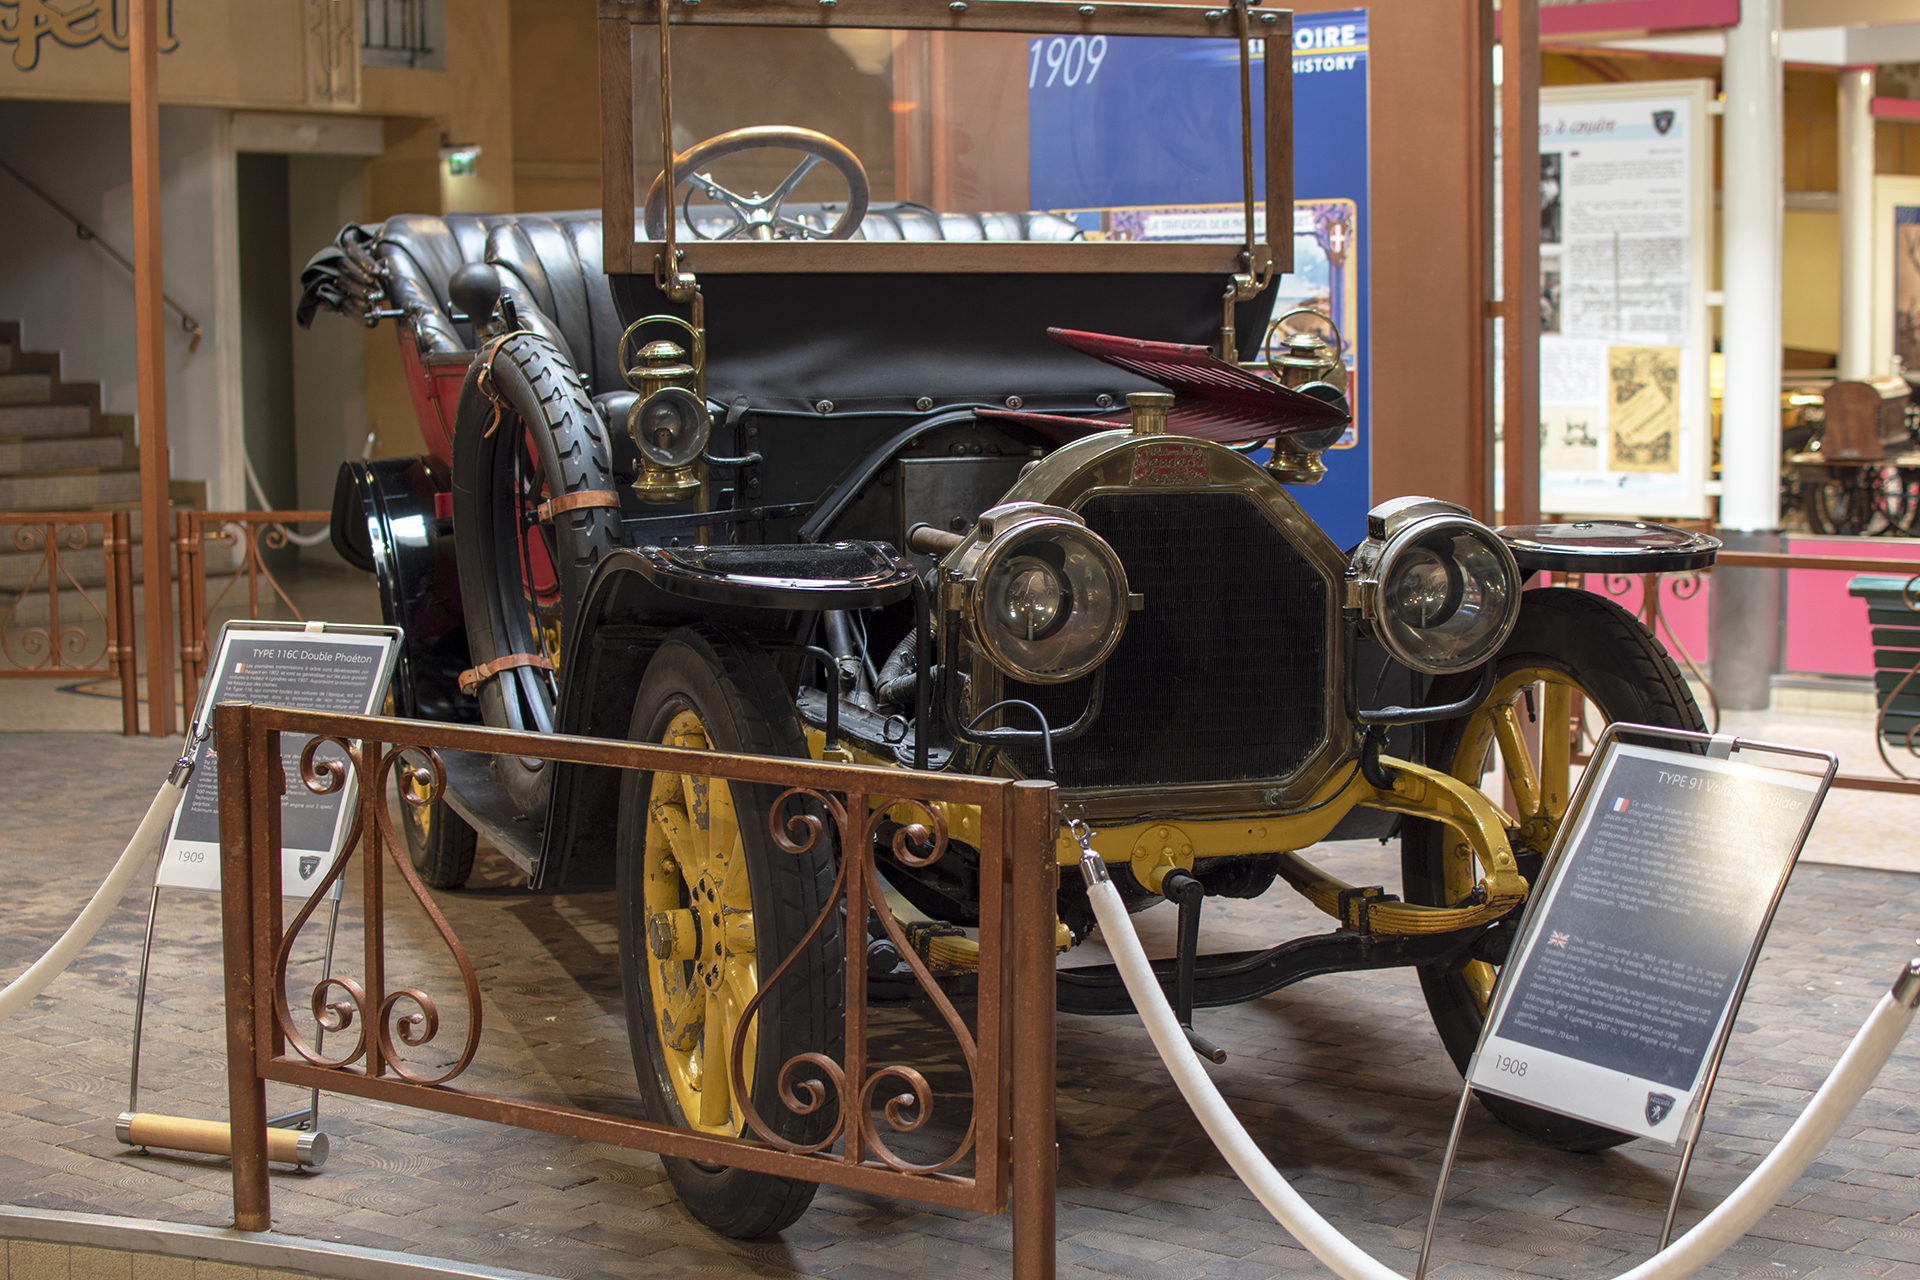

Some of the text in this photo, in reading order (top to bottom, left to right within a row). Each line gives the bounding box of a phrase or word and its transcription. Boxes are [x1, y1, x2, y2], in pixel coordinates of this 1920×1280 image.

[1029, 35, 1107, 88] 1909
[253, 648, 372, 663] TYPE 116C Double Phaéton
[1658, 770, 1688, 787] TYPE
[1688, 777, 1703, 791] 91
[1765, 791, 1802, 813] Spider
[178, 851, 205, 863] 1909
[1496, 1055, 1528, 1077] 1908
